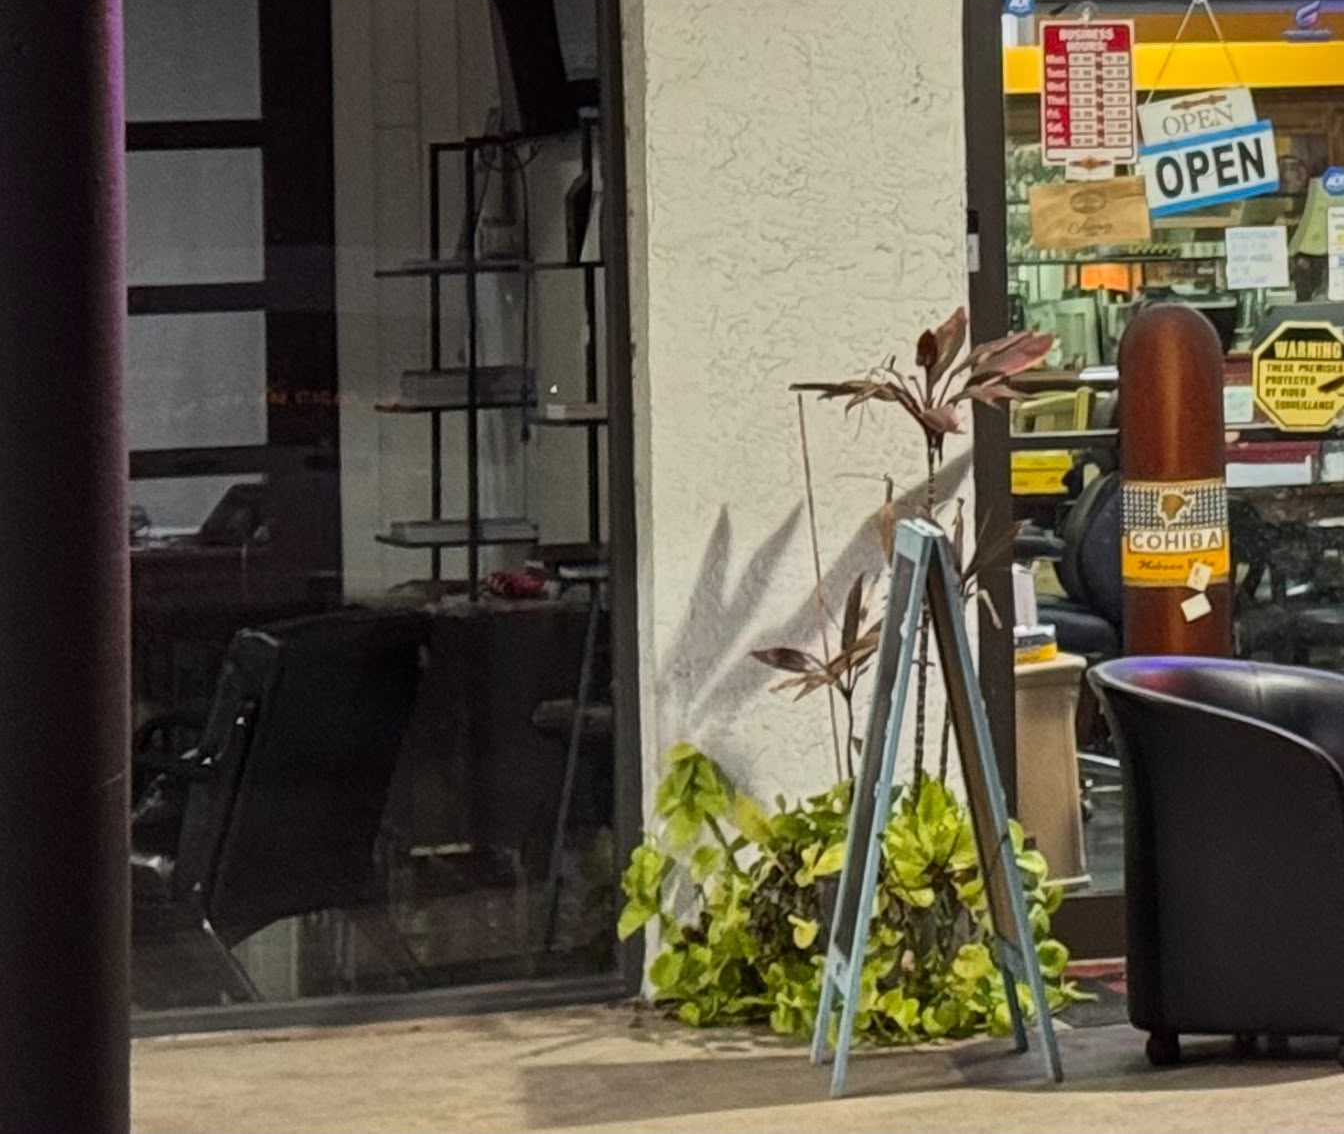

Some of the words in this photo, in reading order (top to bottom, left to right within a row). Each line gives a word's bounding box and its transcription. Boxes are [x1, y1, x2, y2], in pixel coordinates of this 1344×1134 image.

[1161, 103, 1235, 137] OPEN
[1155, 137, 1267, 199] OPEN
[1274, 340, 1343, 359] WARNING
[1266, 364, 1294, 373] THESE
[1265, 375, 1316, 385] PROTECTED
[1265, 388, 1277, 397] BY
[1280, 388, 1307, 397] VIDEO
[1132, 531, 1220, 550] COHIBA
